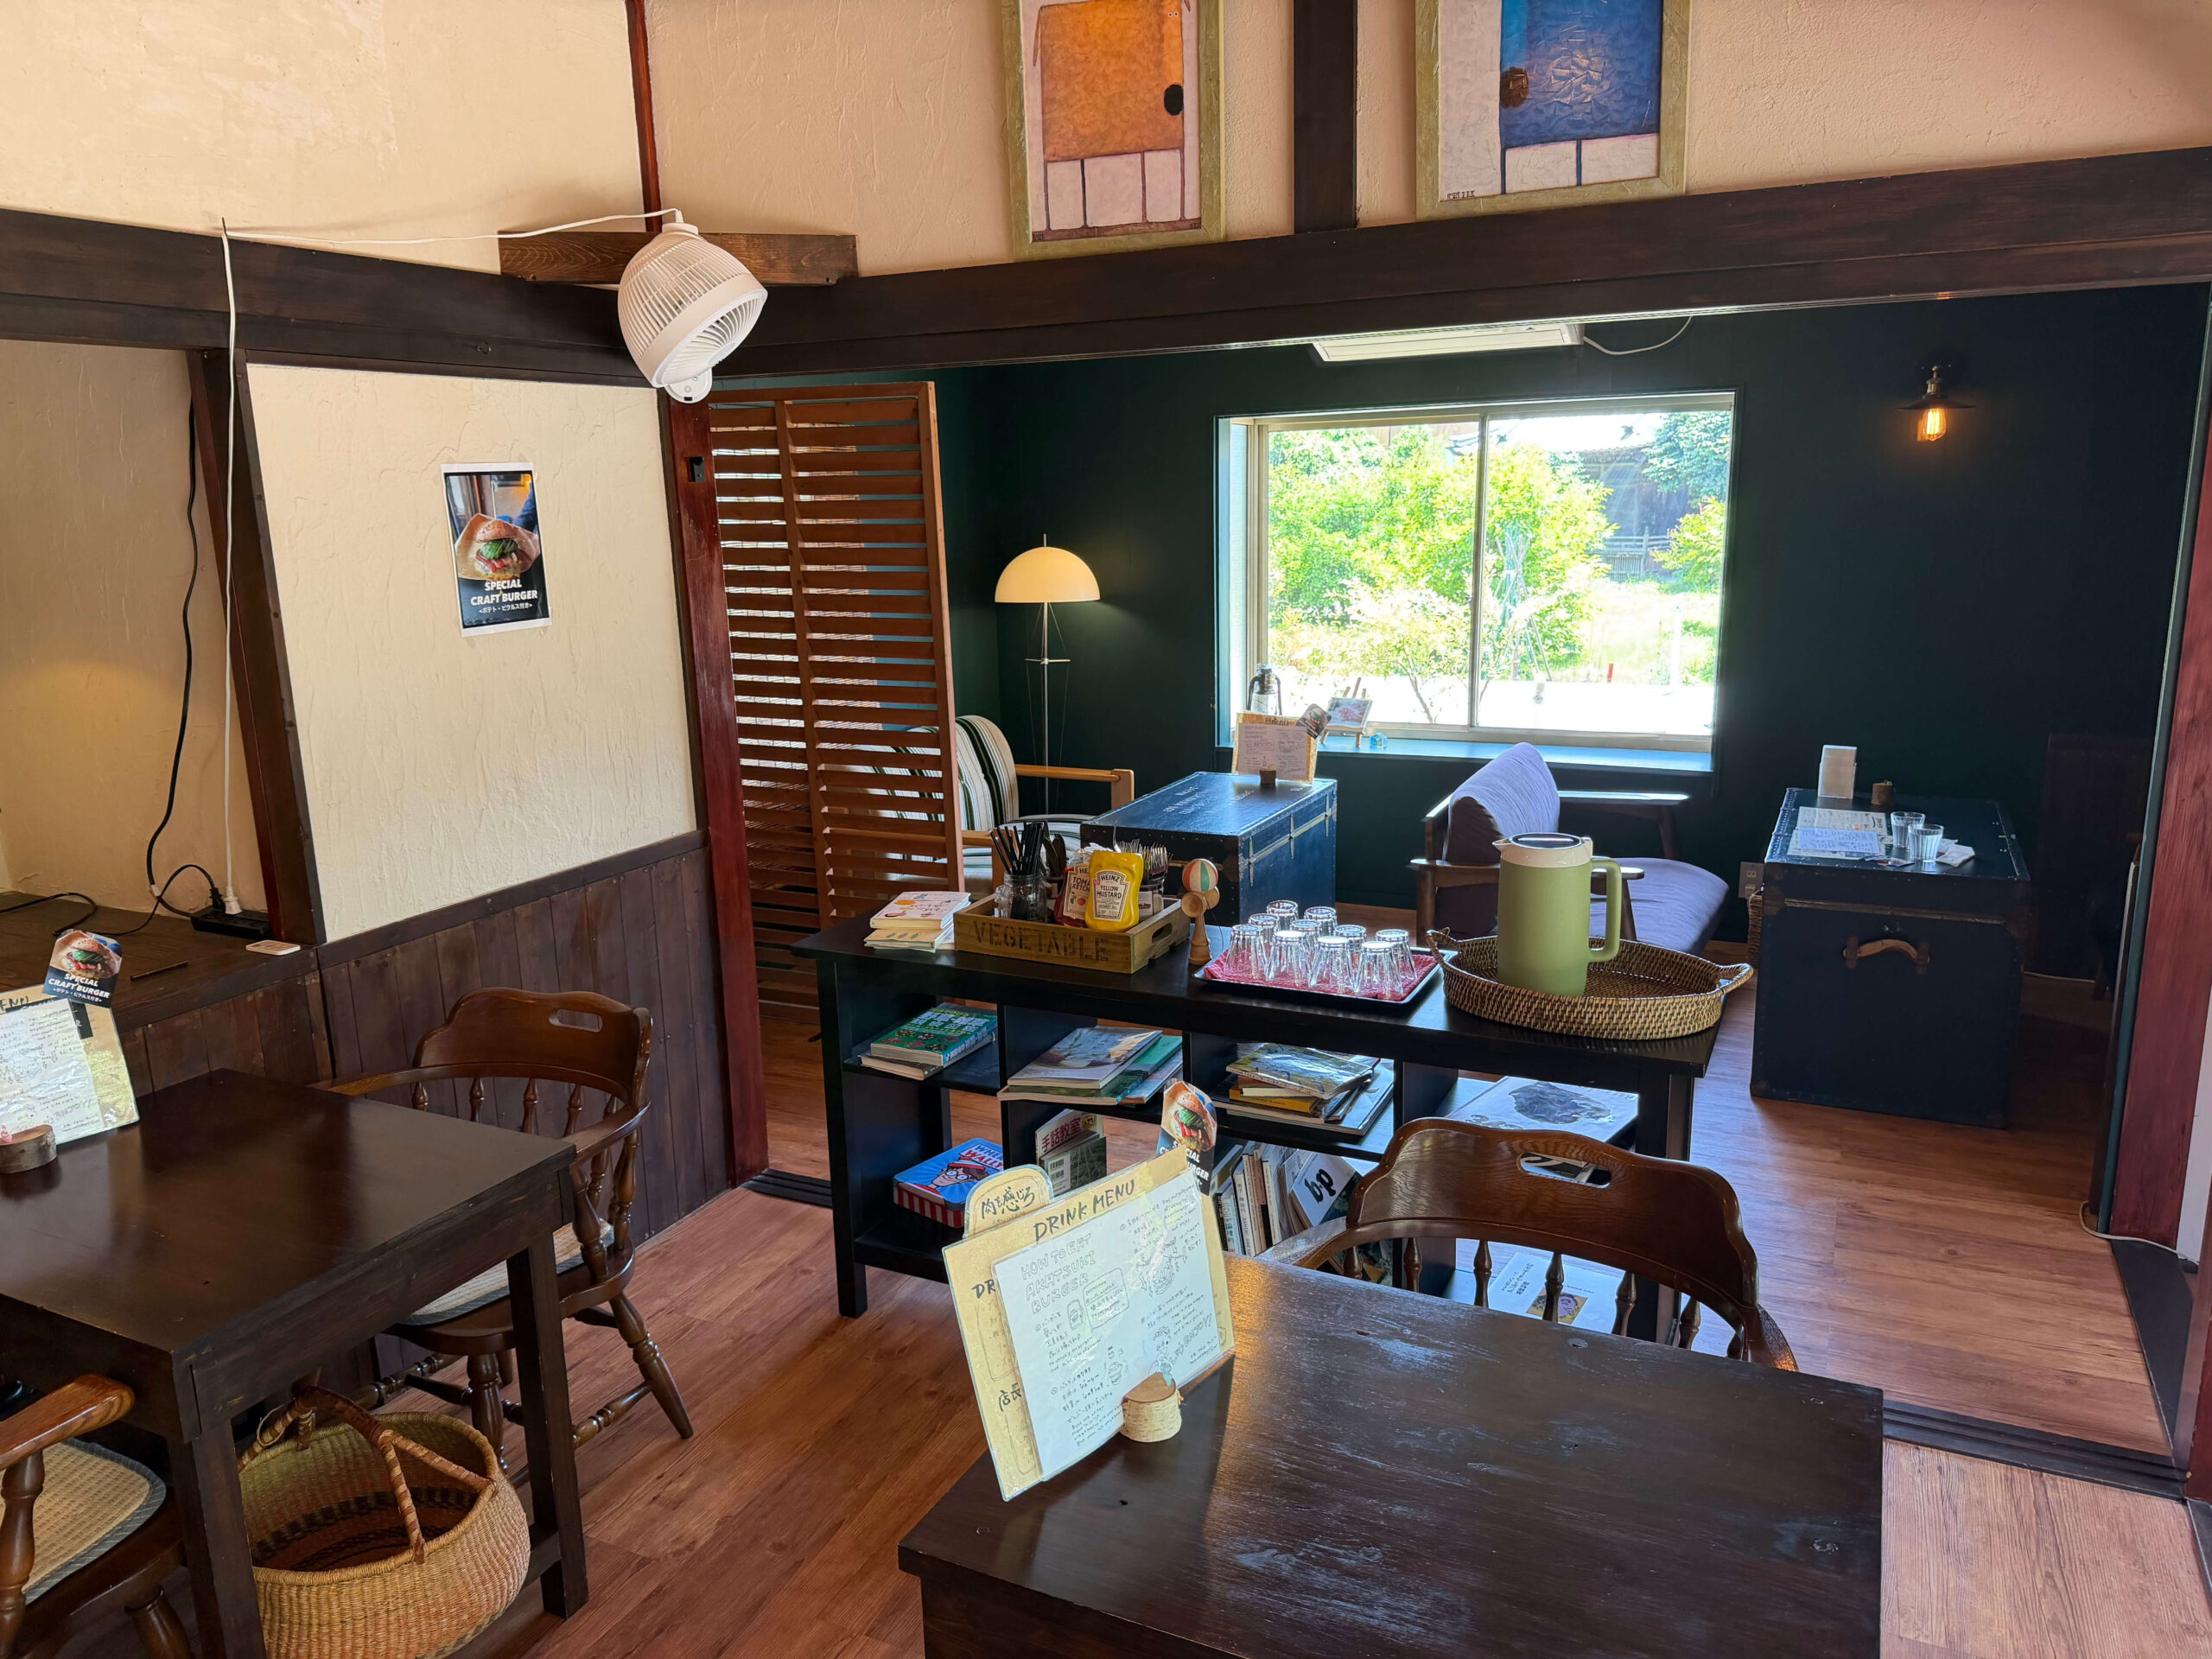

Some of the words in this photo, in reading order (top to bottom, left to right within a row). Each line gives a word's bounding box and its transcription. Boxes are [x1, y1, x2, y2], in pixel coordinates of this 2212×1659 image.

[470, 594, 501, 607] CRAFT
[501, 589, 538, 603] BURGER
[484, 578, 523, 592] SPECIAL
[1100, 874, 1121, 883] HEINZ
[973, 919, 1110, 962] VEGETABLE
[48, 978, 77, 990] CRAFT
[76, 985, 111, 999] BURGER
[64, 973, 99, 988] SPECIAL
[1041, 1116, 1082, 1153] 手話教室
[981, 1185, 1035, 1220] 肉を感じろ
[1033, 1201, 1087, 1245] DRINK
[1092, 1179, 1135, 1215] MENU
[1020, 1253, 1049, 1281] HOW
[1066, 1233, 1092, 1255] EAT
[1026, 1250, 1096, 1301] AKATSUKI
[1031, 1273, 1090, 1315] BURGER
